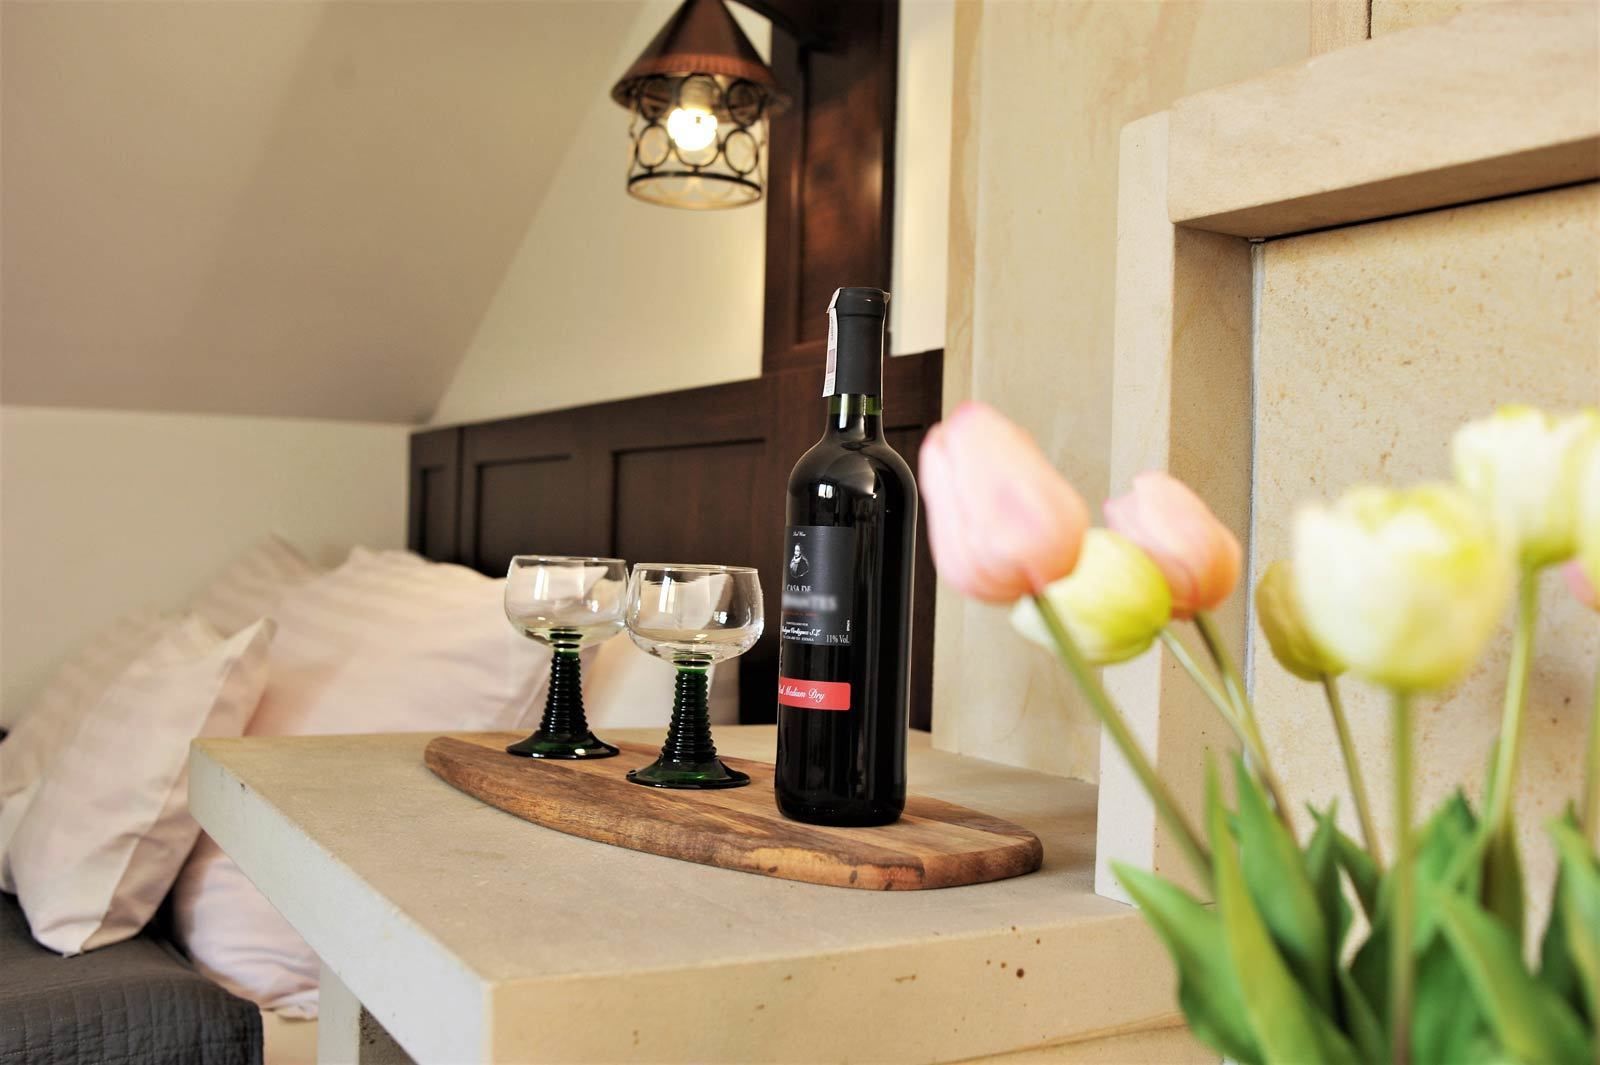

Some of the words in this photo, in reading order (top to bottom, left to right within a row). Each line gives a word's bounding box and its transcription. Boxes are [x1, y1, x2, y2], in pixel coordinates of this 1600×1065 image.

[786, 584, 800, 592] CASA
[826, 634, 838, 643] 11%
[839, 634, 850, 644] Vol.
[808, 687, 825, 703] Dry
